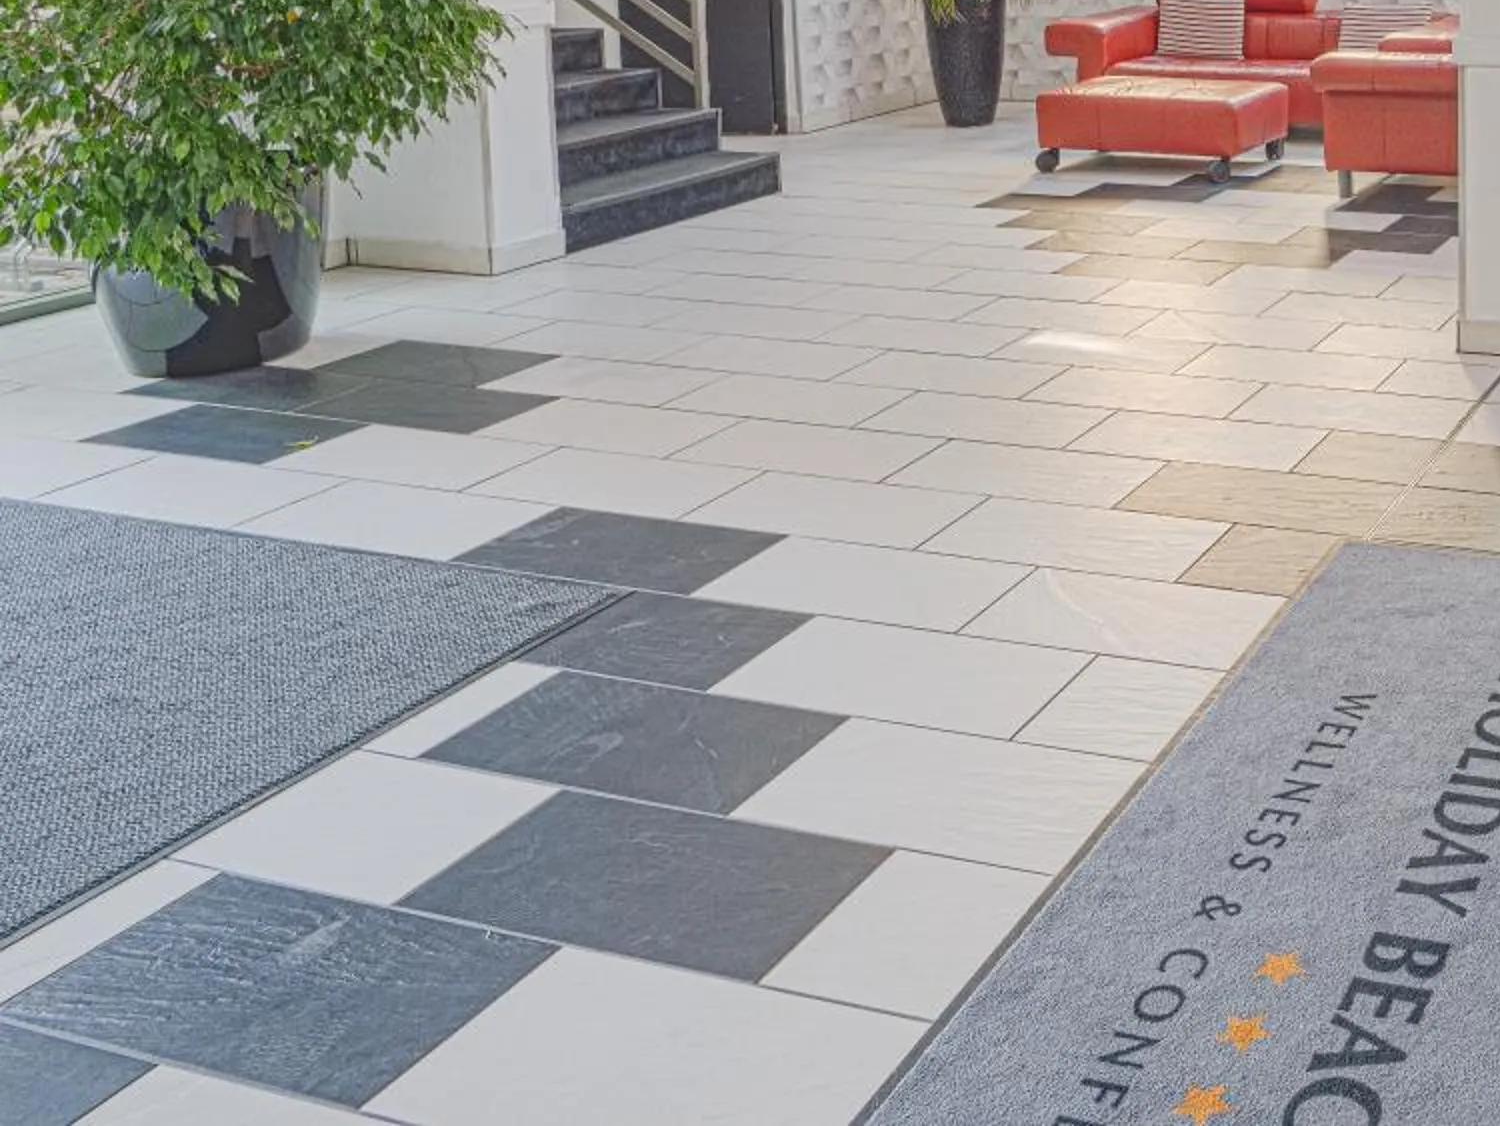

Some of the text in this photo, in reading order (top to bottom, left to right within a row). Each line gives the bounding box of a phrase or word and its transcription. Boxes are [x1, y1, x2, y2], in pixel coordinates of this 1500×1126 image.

[1050, 693, 1378, 1126] WELLNESS & CONF
